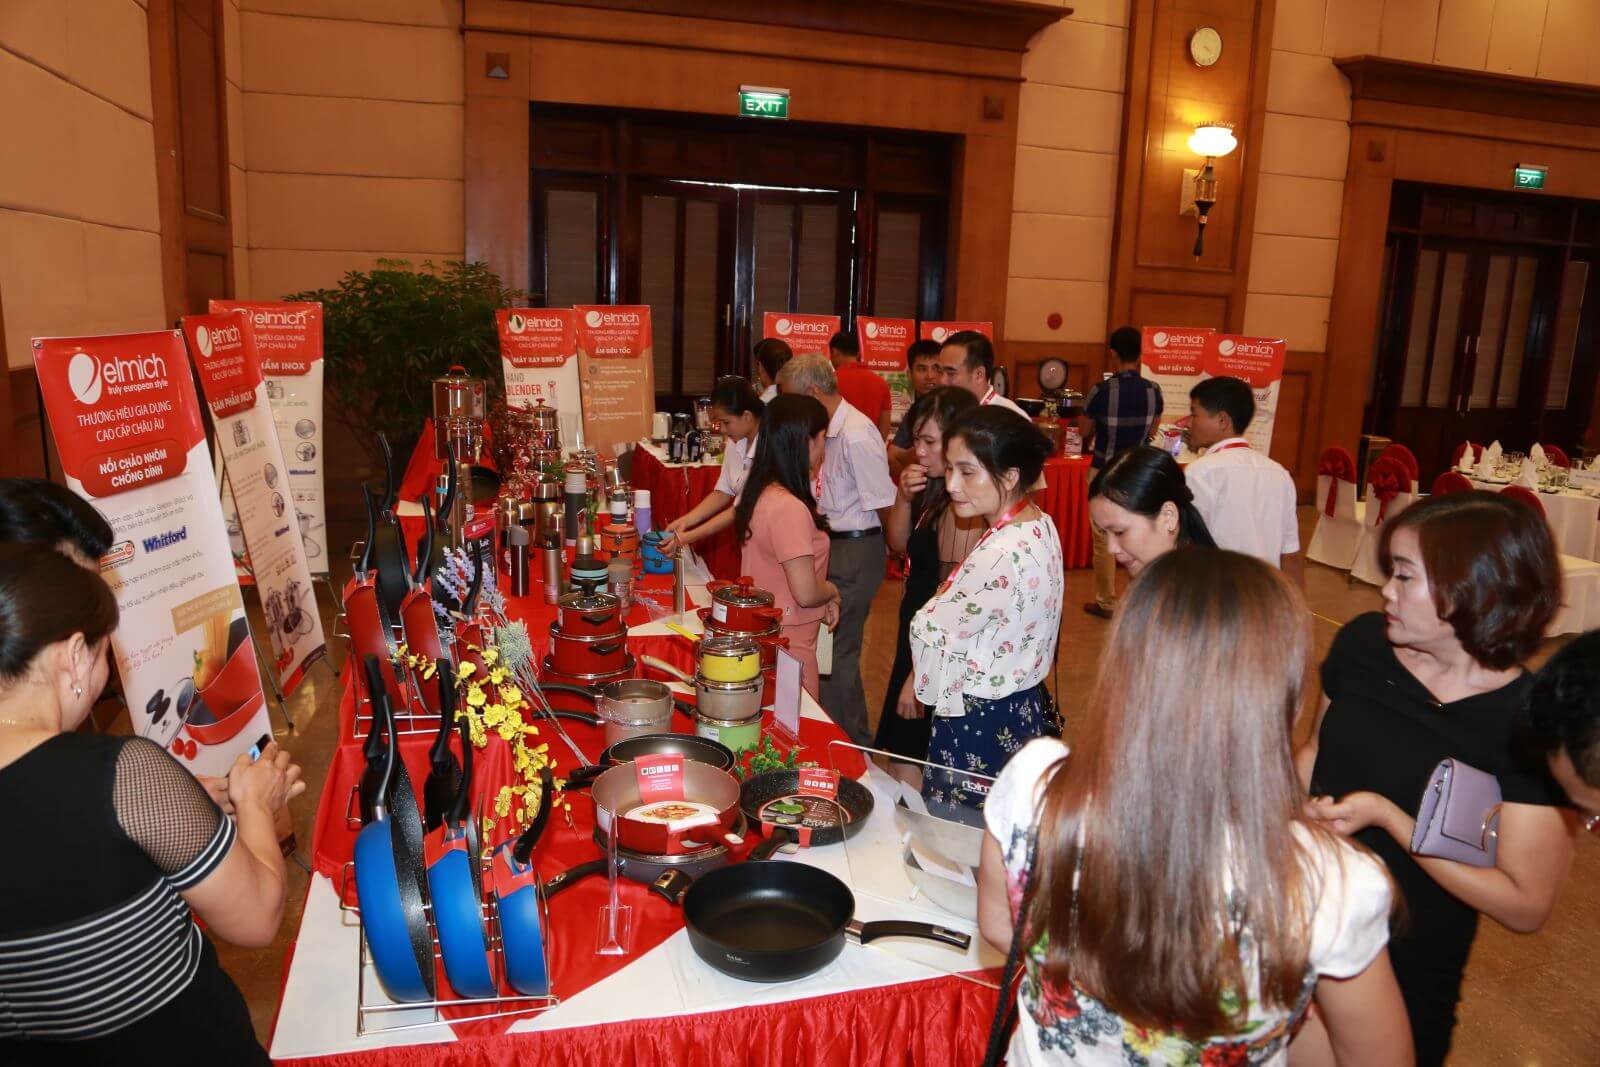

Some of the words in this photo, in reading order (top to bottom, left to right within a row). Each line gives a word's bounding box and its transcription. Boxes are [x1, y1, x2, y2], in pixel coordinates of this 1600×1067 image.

[745, 98, 783, 113] EXIT
[254, 311, 306, 325] elmich
[526, 316, 563, 328] elmich
[603, 312, 640, 323] elmich
[793, 321, 829, 333] elmich
[879, 324, 907, 335] elmich
[211, 324, 241, 345] elmich
[1169, 334, 1205, 344] elmich
[1236, 343, 1274, 355] elmich
[103, 352, 167, 384] elmich
[281, 361, 305, 370] INOX
[107, 385, 122, 395] truly
[123, 381, 154, 394] european
[154, 380, 168, 390] style
[506, 384, 541, 396] BLENDER
[77, 410, 116, 427] THƯƠNG
[115, 406, 134, 421] HIỆU
[135, 404, 148, 418] GIA
[149, 400, 171, 416] DỤNG
[96, 428, 115, 442] CAO
[115, 423, 131, 438] CẤP
[131, 420, 153, 435] CHÂU
[153, 417, 165, 431] ÂU
[99, 456, 118, 475] NỒI
[119, 452, 143, 470] CHẢO
[143, 448, 168, 464] NHÔM
[111, 468, 144, 487] CHỐNG
[144, 464, 164, 478] DÍNH
[142, 525, 187, 554] Whitford
